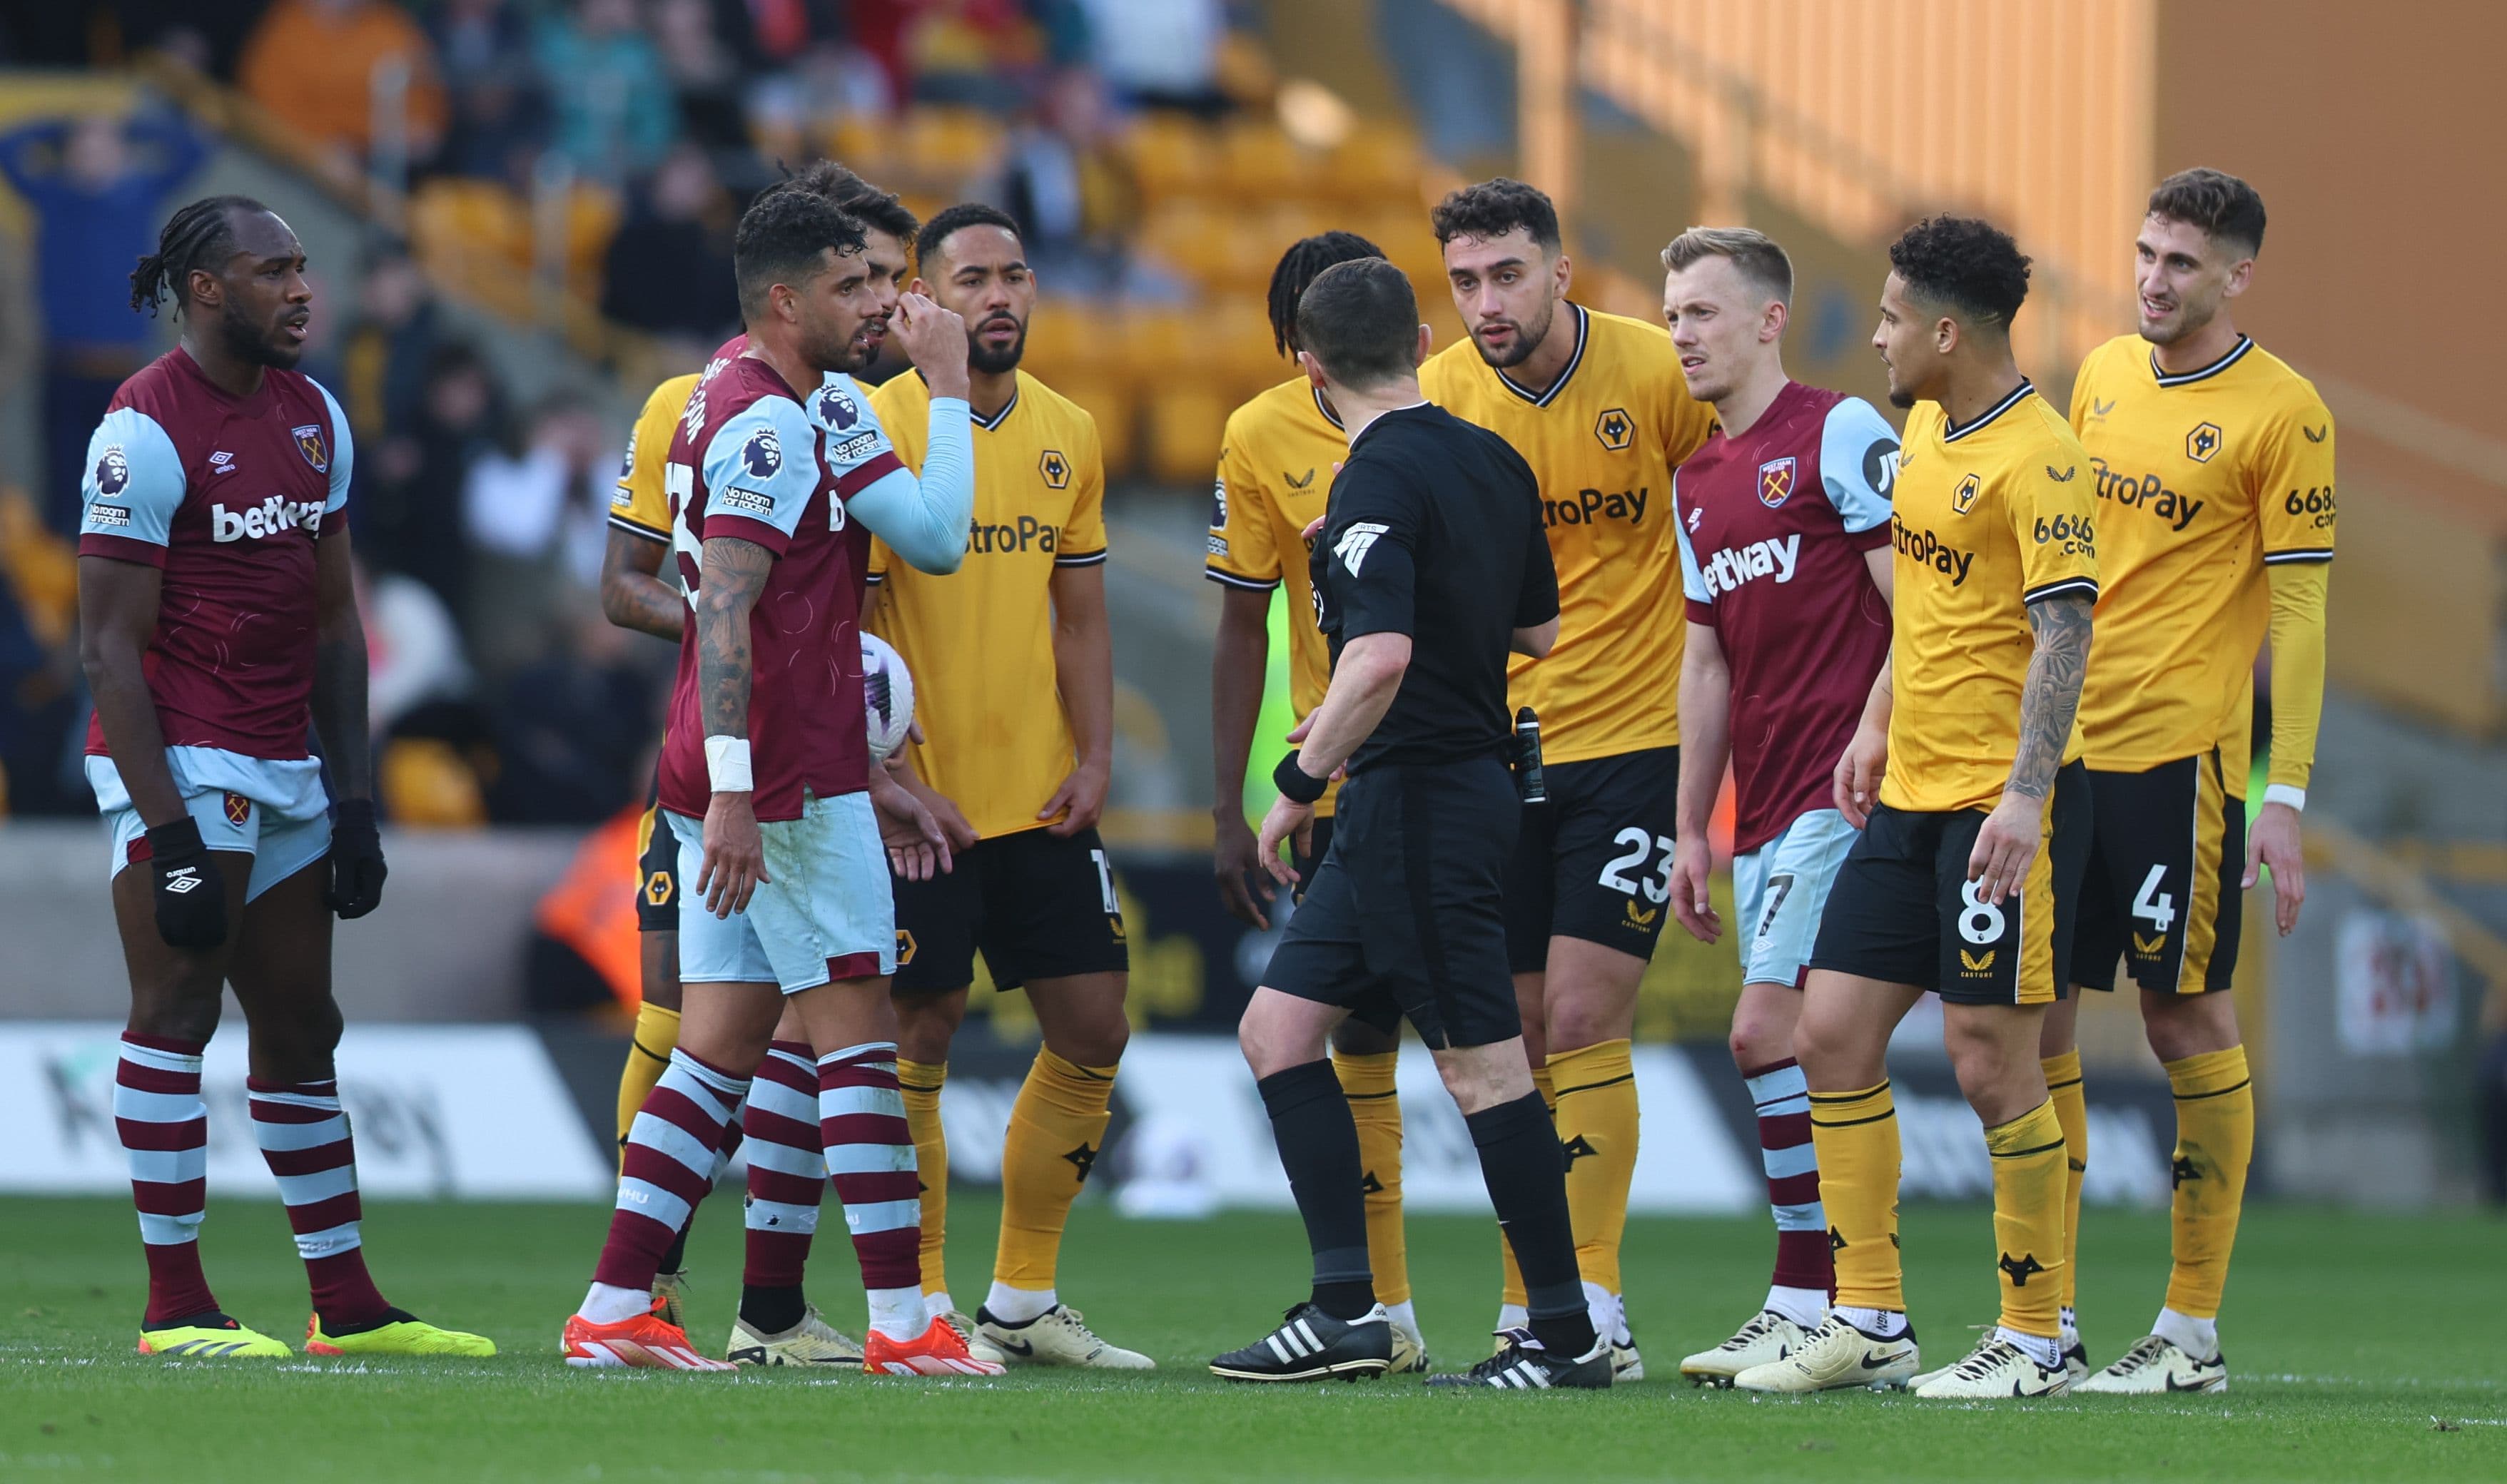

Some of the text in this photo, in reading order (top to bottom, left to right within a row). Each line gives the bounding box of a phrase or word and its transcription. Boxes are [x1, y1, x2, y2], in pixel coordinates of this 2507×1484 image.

[832, 432, 875, 457] No room
[836, 439, 881, 463] for racism
[215, 464, 236, 474] umbro
[99, 506, 126, 518] room
[721, 495, 772, 517] for racism
[724, 486, 771, 507] No room
[1544, 487, 1648, 529] roPay
[2091, 457, 2204, 532] troPay
[2285, 485, 2336, 516] 668
[98, 515, 130, 527] racism
[212, 494, 327, 543] betwa
[965, 515, 1060, 554] troPa
[2033, 514, 2094, 544] 6686
[1703, 534, 1801, 598] etway
[1891, 511, 1975, 587] stroPay
[2060, 541, 2095, 560] .com
[1598, 826, 1676, 904] 23
[1758, 874, 1795, 937] 7
[1958, 874, 2006, 945] 8
[2131, 863, 2176, 932] 4
